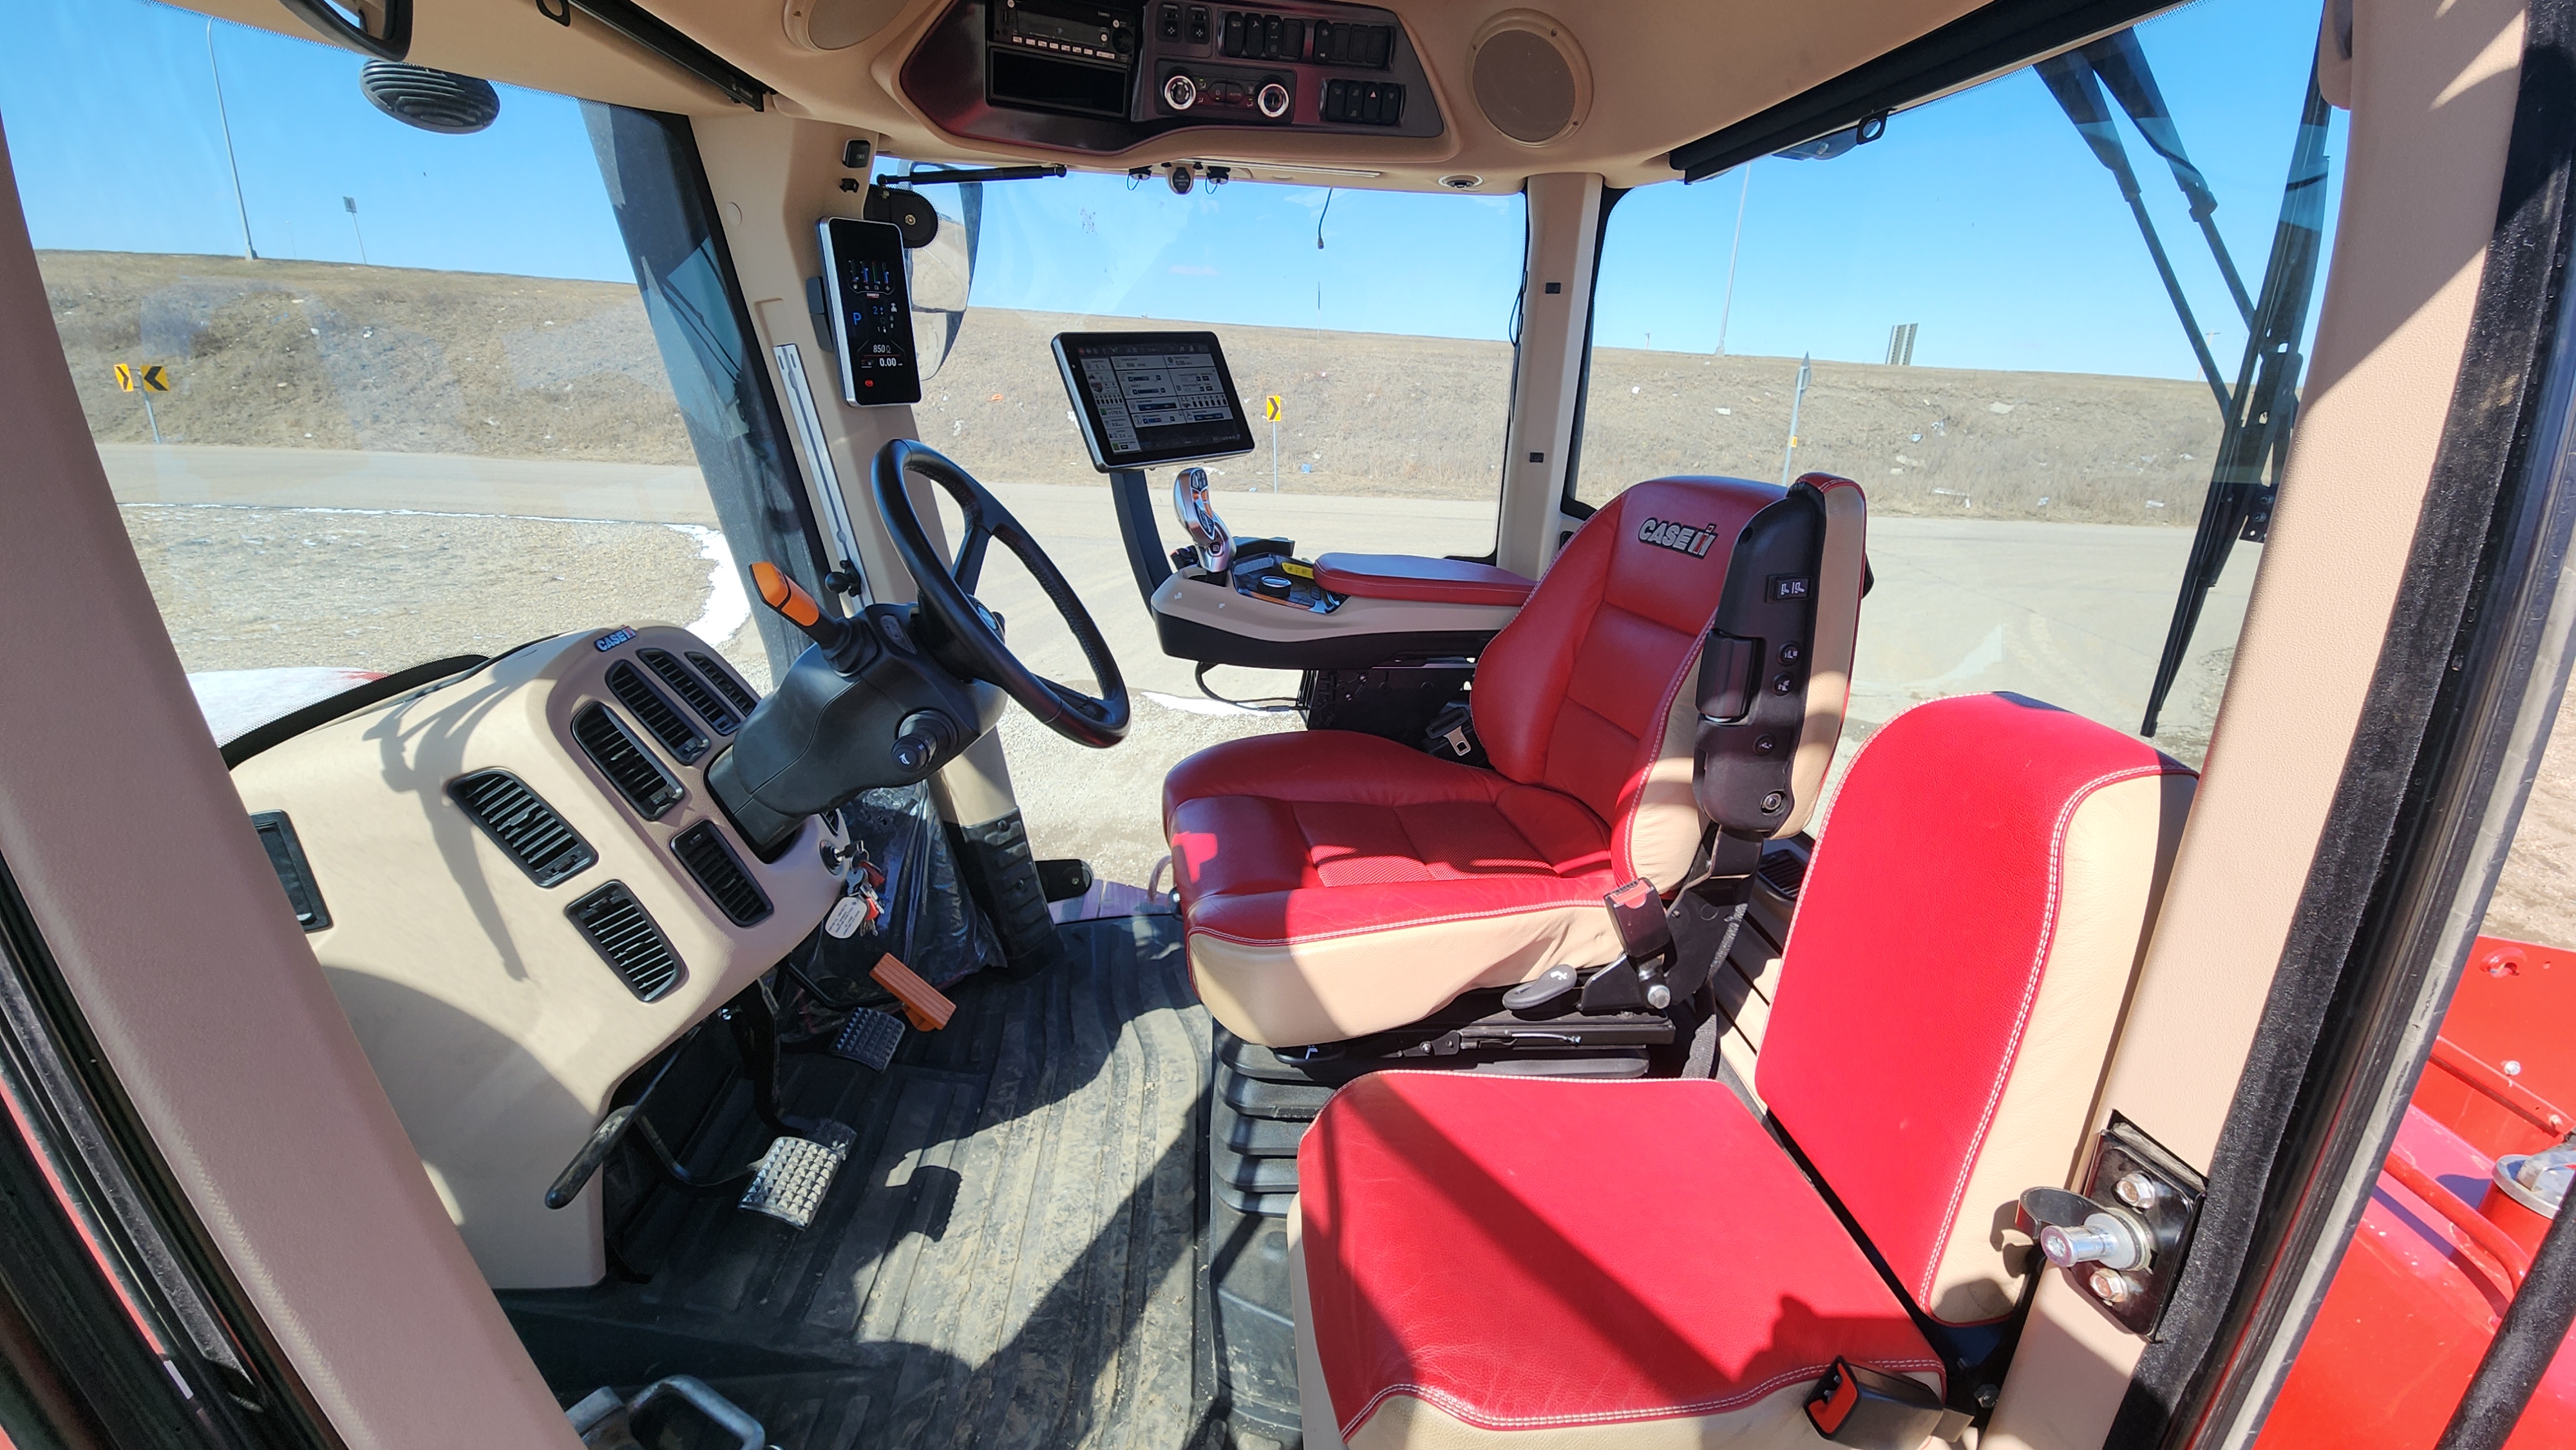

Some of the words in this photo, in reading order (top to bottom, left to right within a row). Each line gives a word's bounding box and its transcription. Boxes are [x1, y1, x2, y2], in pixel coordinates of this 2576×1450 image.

[873, 306, 878, 315] 2
[853, 312, 862, 325] P
[873, 344, 886, 353] 850
[879, 357, 896, 367] 0.00
[1639, 519, 1695, 551] CASE
[596, 631, 627, 651] CASE
